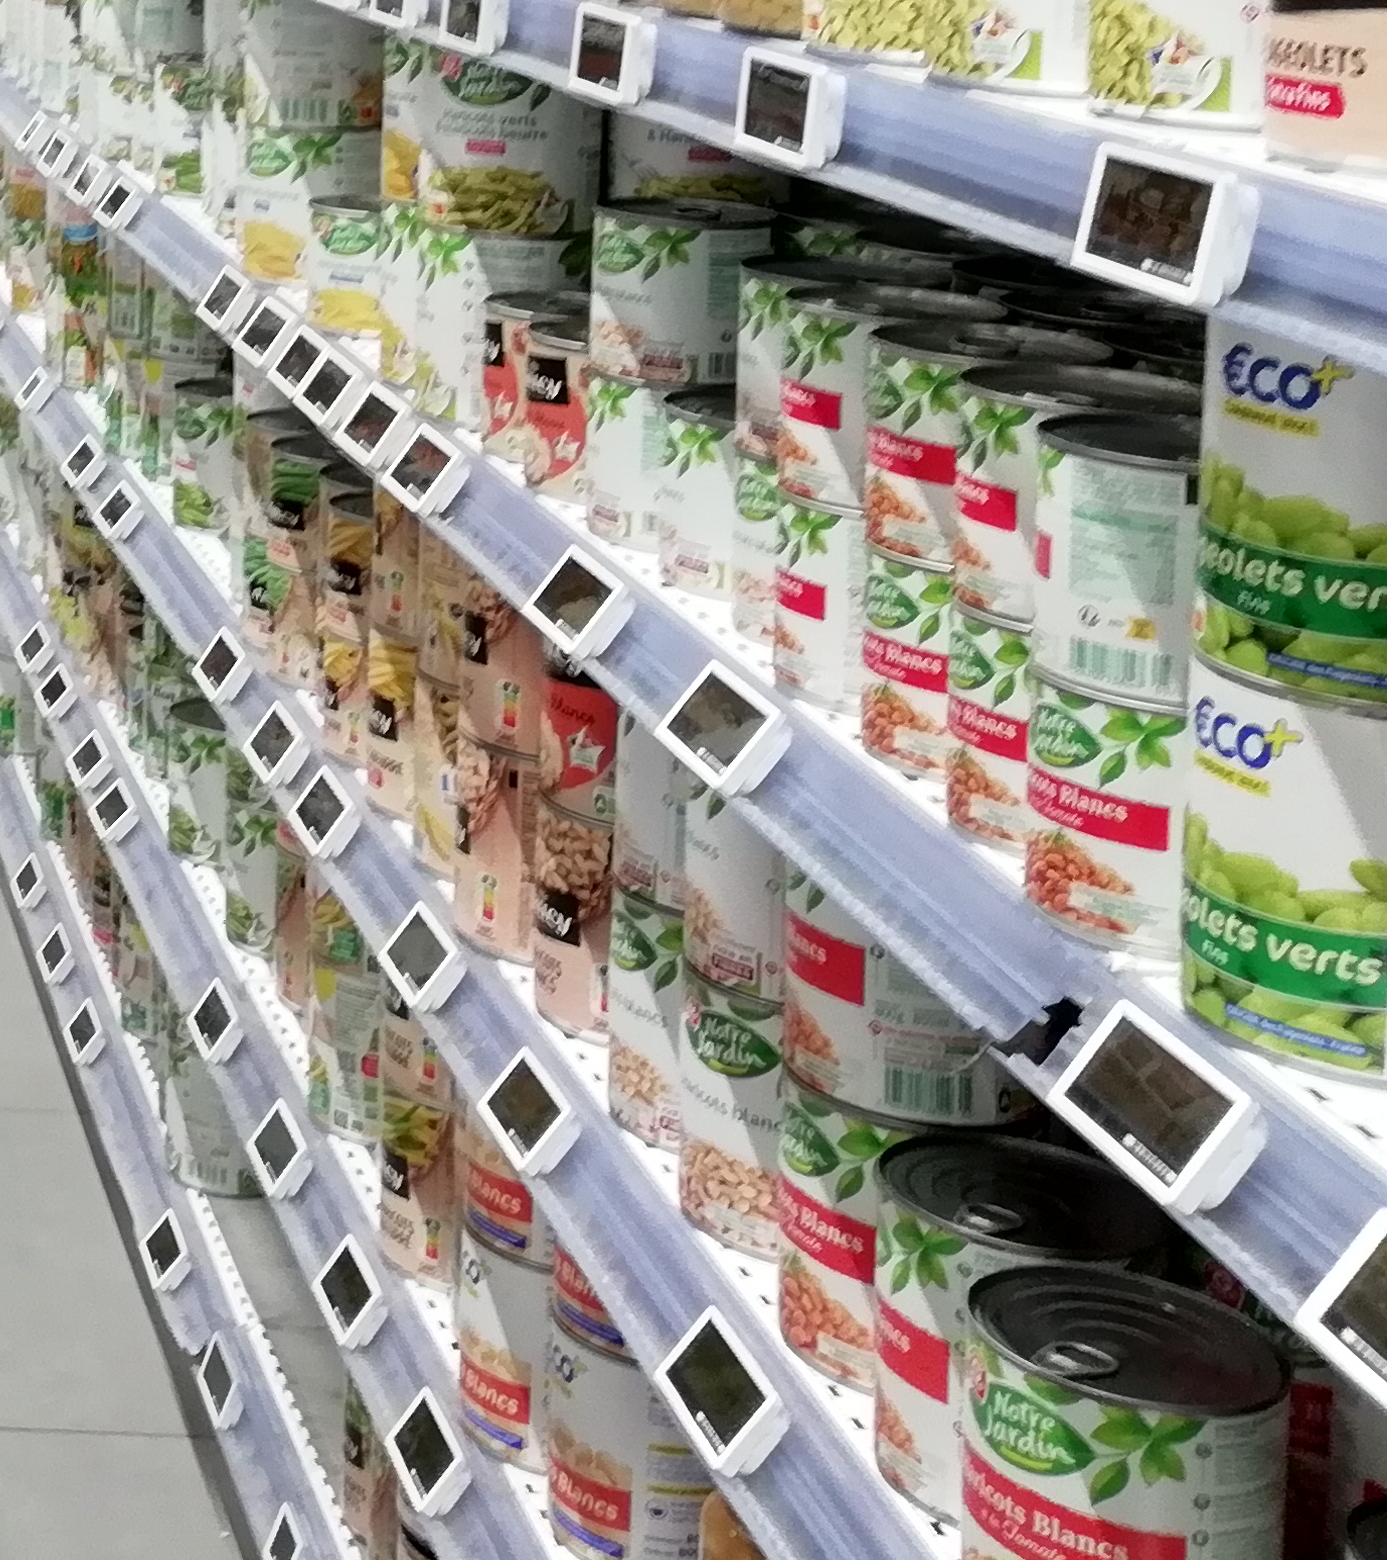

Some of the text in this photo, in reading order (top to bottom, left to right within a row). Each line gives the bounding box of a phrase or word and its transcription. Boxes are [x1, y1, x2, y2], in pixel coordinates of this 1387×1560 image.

[1058, 784, 1130, 824] Blancs
[1265, 933, 1385, 987] verts
[992, 1387, 1057, 1432] Notre
[982, 1404, 1078, 1467] Jardin
[1030, 1510, 1131, 1560] Blancs
